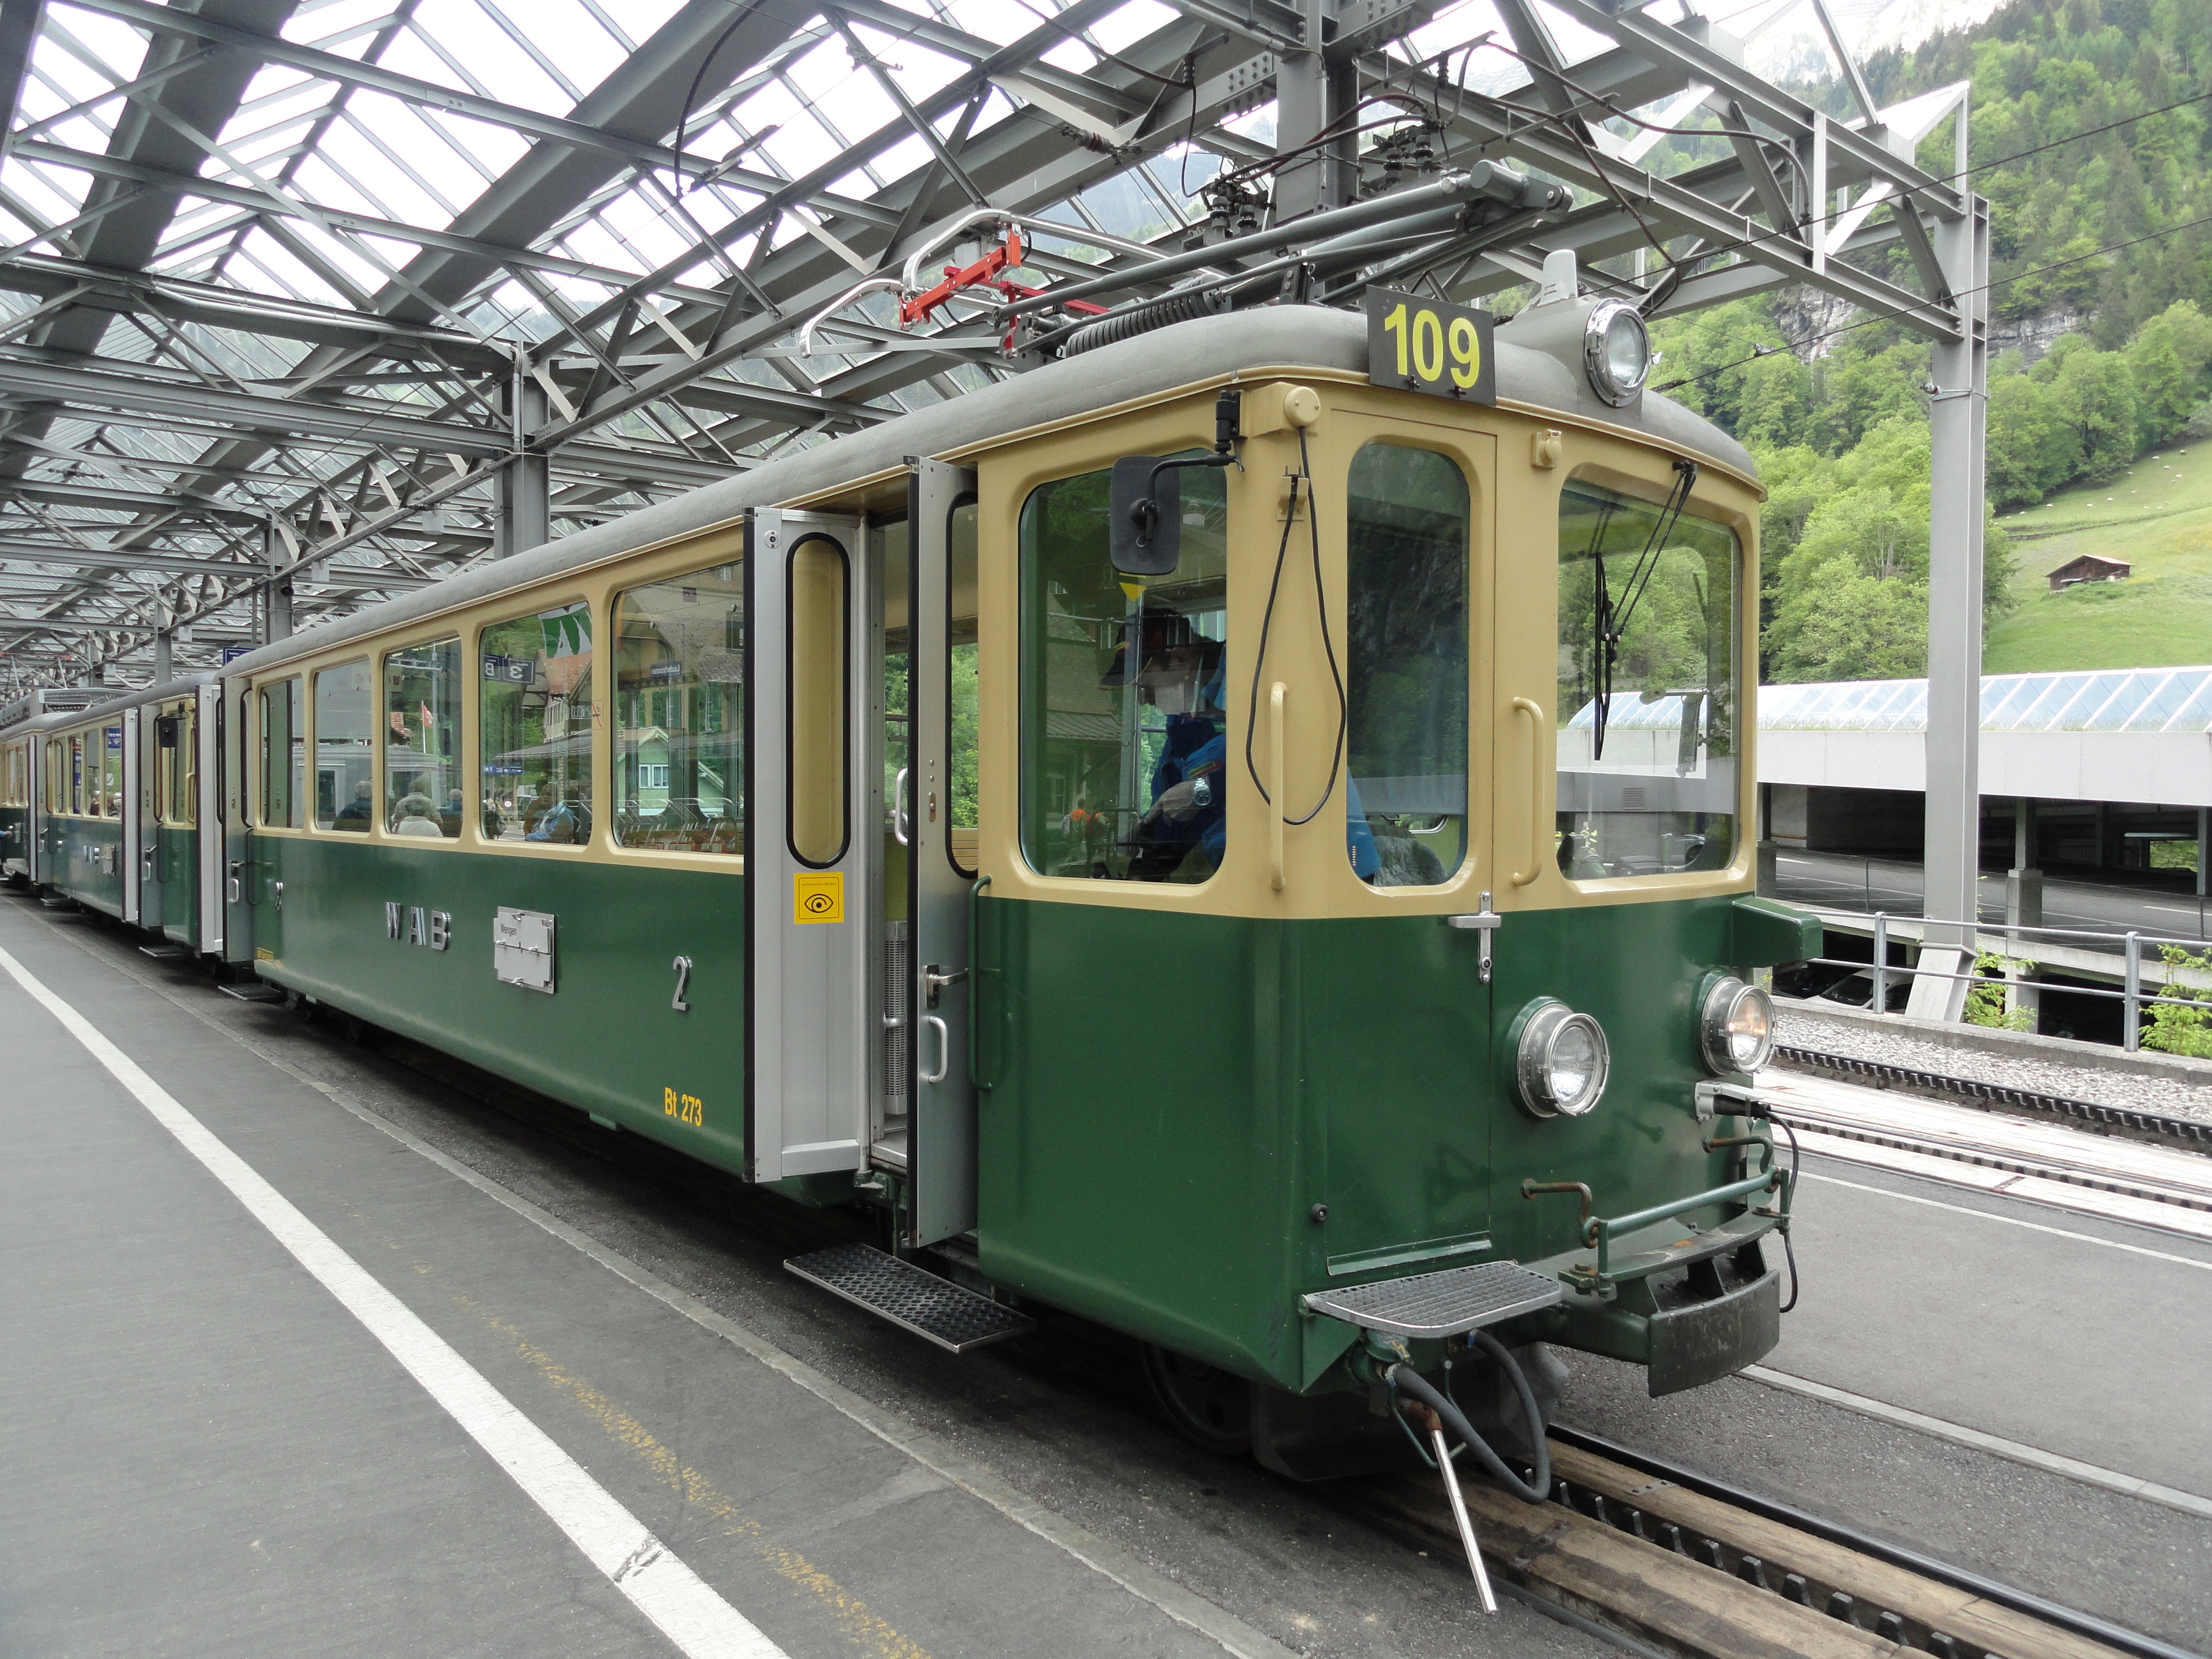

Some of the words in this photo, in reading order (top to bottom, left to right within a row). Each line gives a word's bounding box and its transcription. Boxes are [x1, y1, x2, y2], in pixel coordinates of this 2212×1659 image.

[1384, 303, 1480, 389] 109
[386, 901, 451, 951] WAB
[500, 923, 518, 937] Wengen
[672, 955, 692, 1011] 2
[665, 1087, 677, 1118] Bt
[681, 1093, 702, 1127] 273
